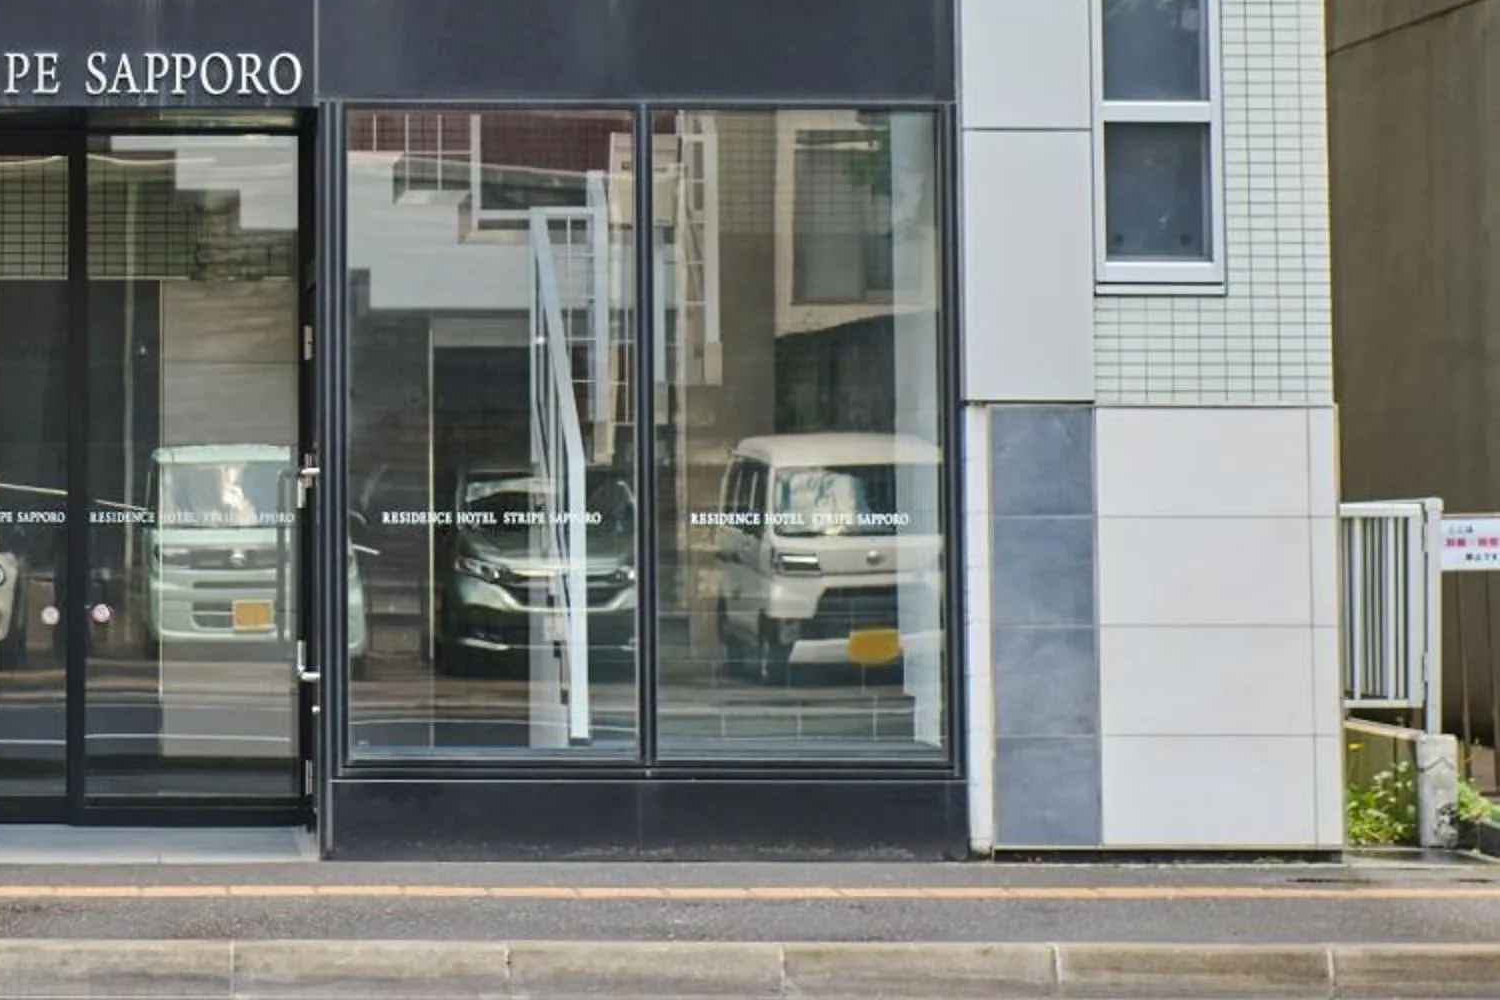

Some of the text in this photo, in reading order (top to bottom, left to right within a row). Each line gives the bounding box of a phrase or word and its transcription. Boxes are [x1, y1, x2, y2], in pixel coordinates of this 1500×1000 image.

[84, 51, 303, 95] SAPPORO
[16, 511, 66, 523] SAPPORO
[89, 511, 156, 523] RESIDENCE
[244, 511, 295, 523] PPORO
[381, 511, 602, 525] RESIDENCE HOTEL STRIPE SAPRO
[690, 512, 761, 525] RESIDENCE
[764, 512, 804, 525] HOTEL
[856, 512, 909, 525] SAPPORO
